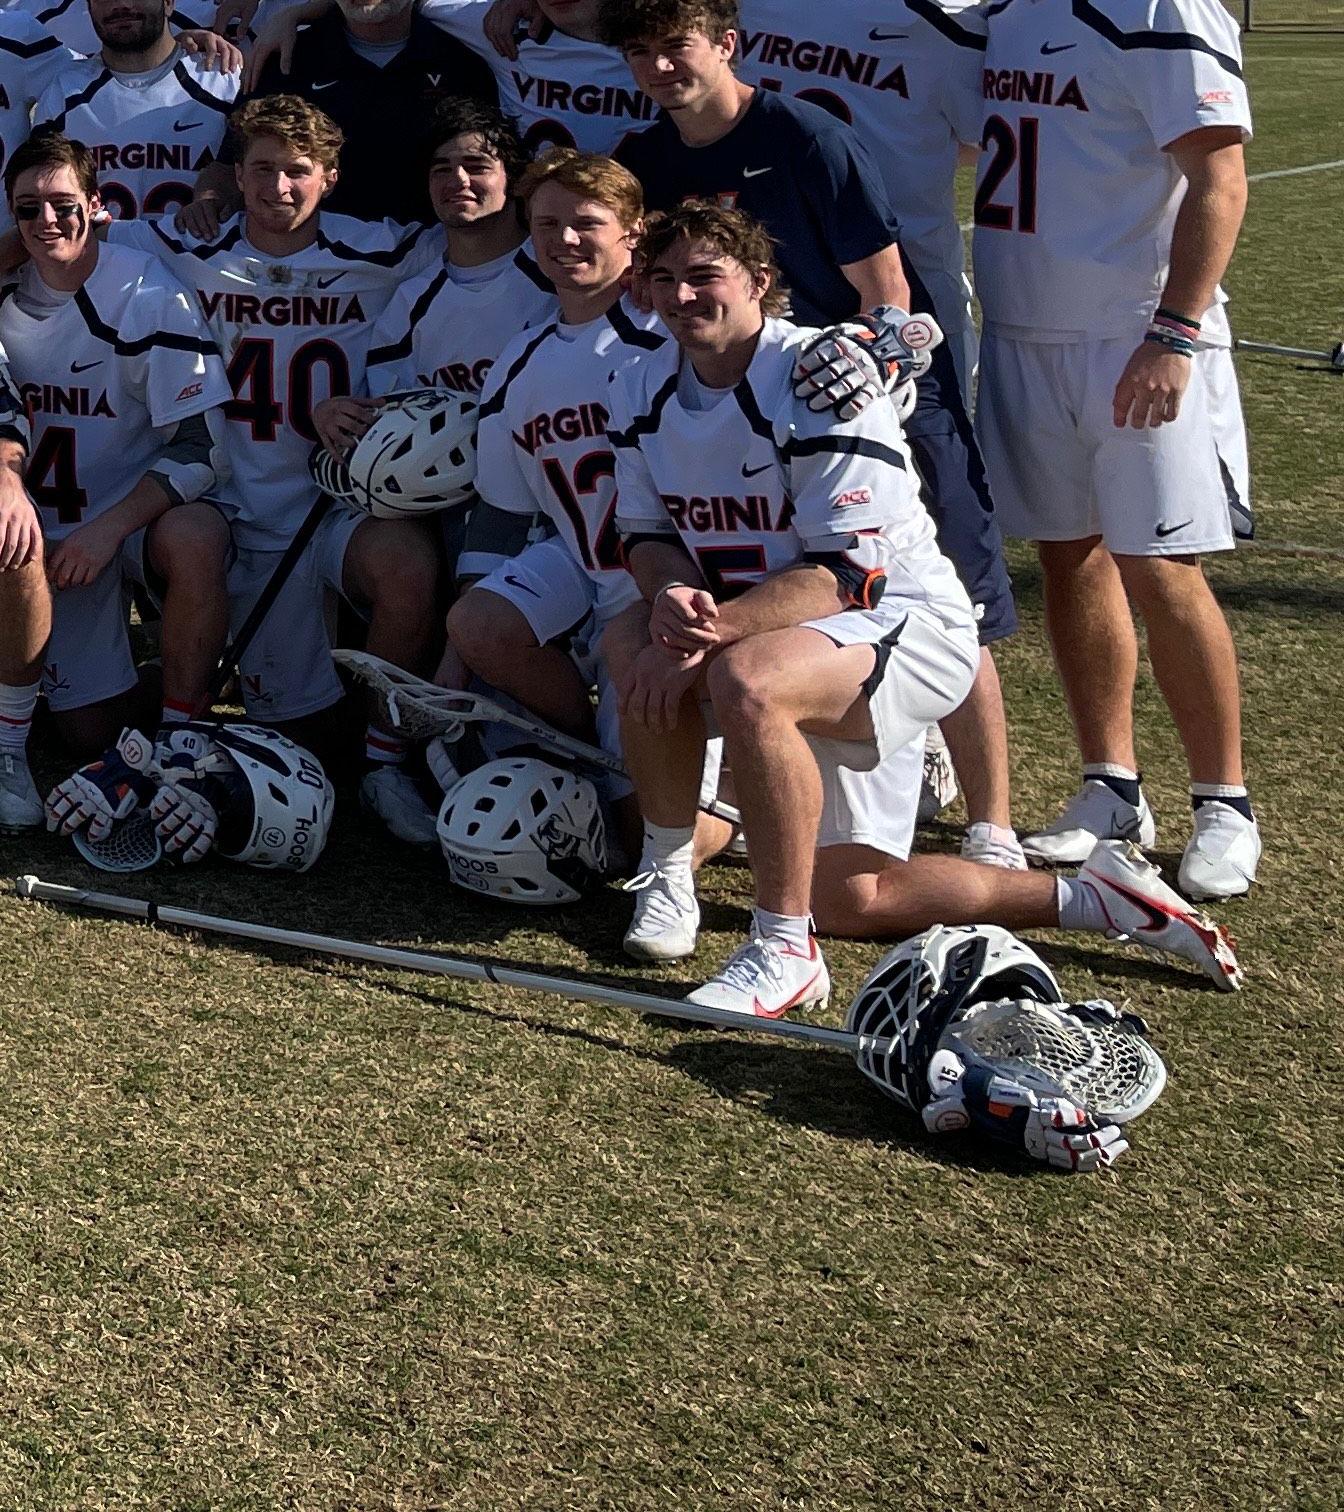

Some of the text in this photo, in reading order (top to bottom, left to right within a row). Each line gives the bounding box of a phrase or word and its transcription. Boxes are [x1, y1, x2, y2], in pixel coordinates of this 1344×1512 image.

[738, 28, 911, 100] VIRGINIA
[512, 69, 662, 122] VIRGINI
[983, 68, 1090, 112] RGINIA
[974, 113, 1040, 235] 21
[196, 288, 367, 327] VIRGINIA
[19, 382, 118, 419] GINIA
[175, 382, 204, 402] ACC
[221, 336, 351, 443] 40
[660, 491, 797, 533] RGINIA
[833, 490, 871, 508] ACC
[286, 816, 313, 870] HOOS
